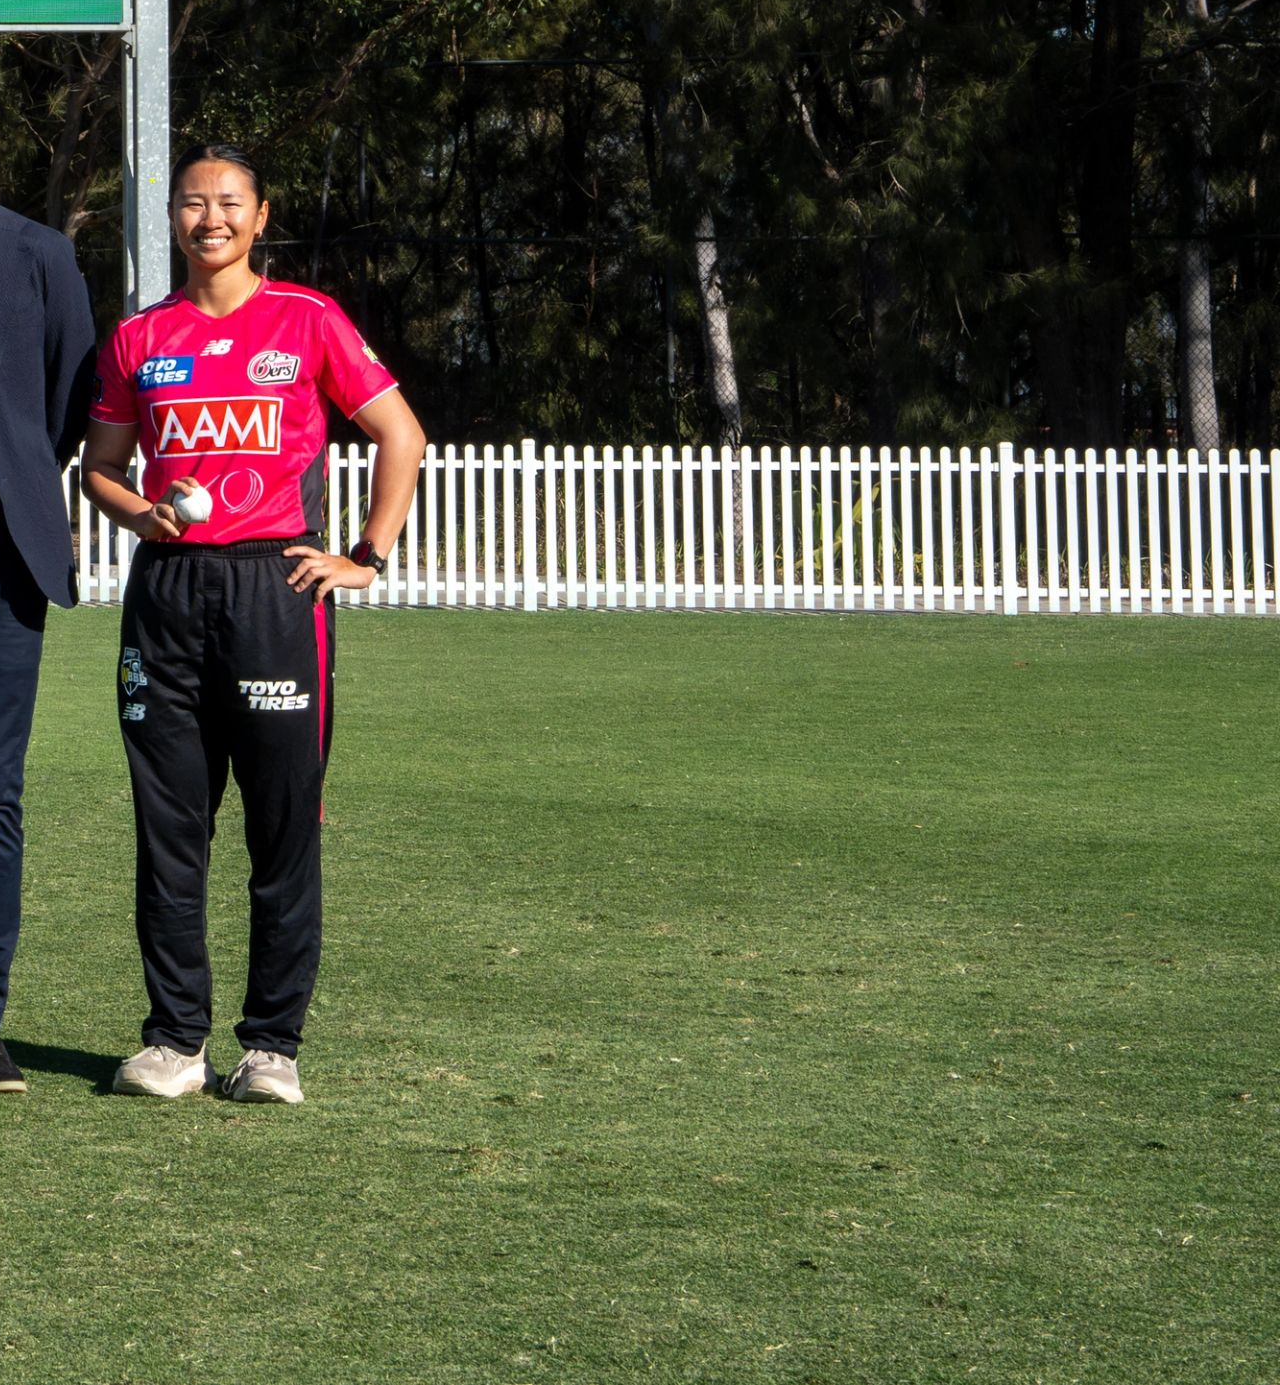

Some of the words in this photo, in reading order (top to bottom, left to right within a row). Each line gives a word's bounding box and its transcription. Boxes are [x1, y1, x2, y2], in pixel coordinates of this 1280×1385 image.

[159, 402, 278, 452] AAMI
[238, 680, 297, 696] TOYO
[248, 693, 310, 711] TIRES
